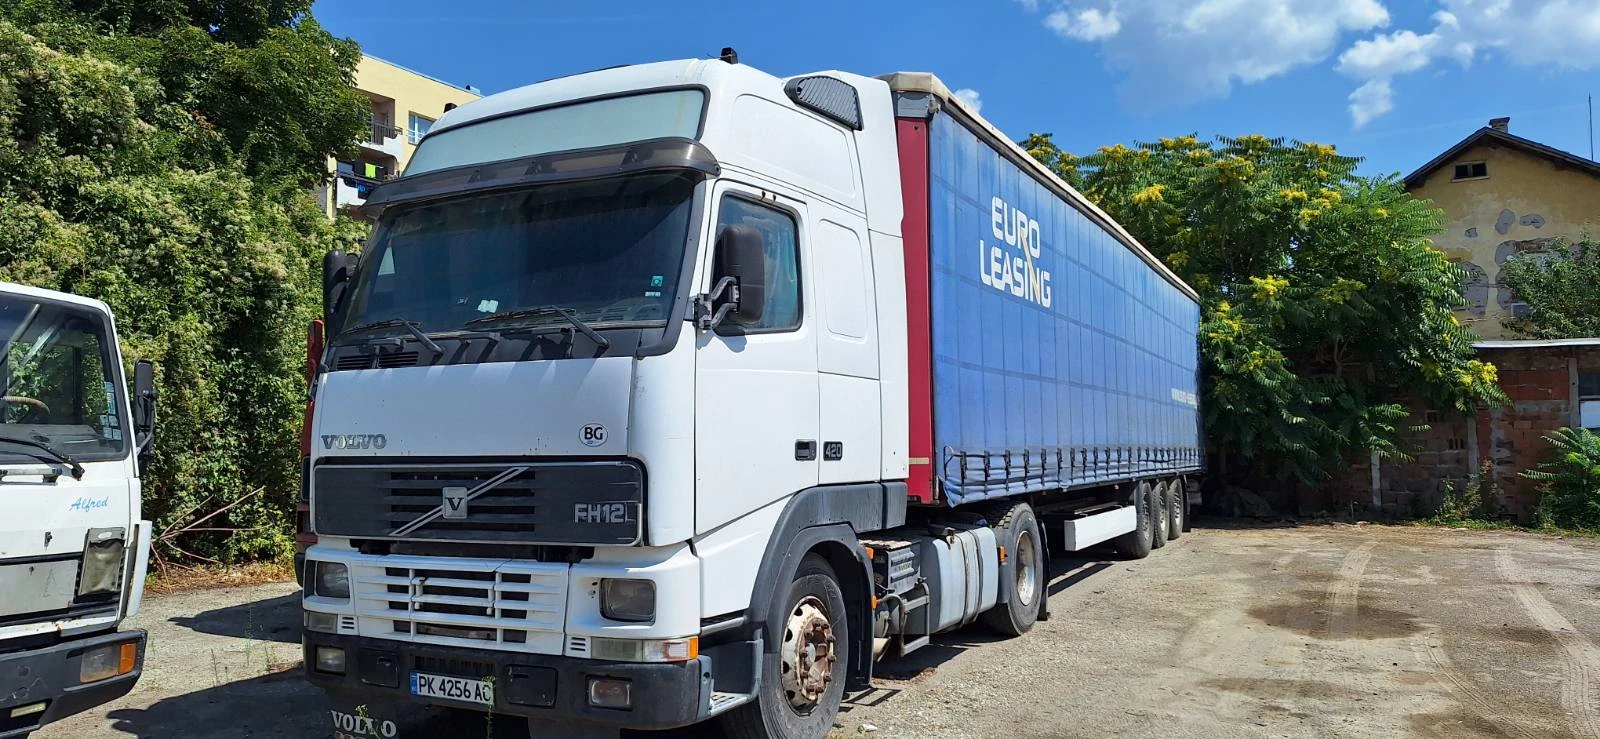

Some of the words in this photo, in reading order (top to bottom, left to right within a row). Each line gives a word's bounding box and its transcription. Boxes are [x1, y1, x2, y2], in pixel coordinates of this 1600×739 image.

[992, 196, 1040, 259] EURO
[980, 239, 1051, 308] LEASING
[584, 427, 603, 440] BG
[321, 434, 387, 450] VOLVO
[825, 443, 842, 458] 420
[69, 497, 109, 512] Alfred
[418, 675, 436, 695] PK
[438, 678, 472, 699] 4256
[474, 682, 492, 702] AC
